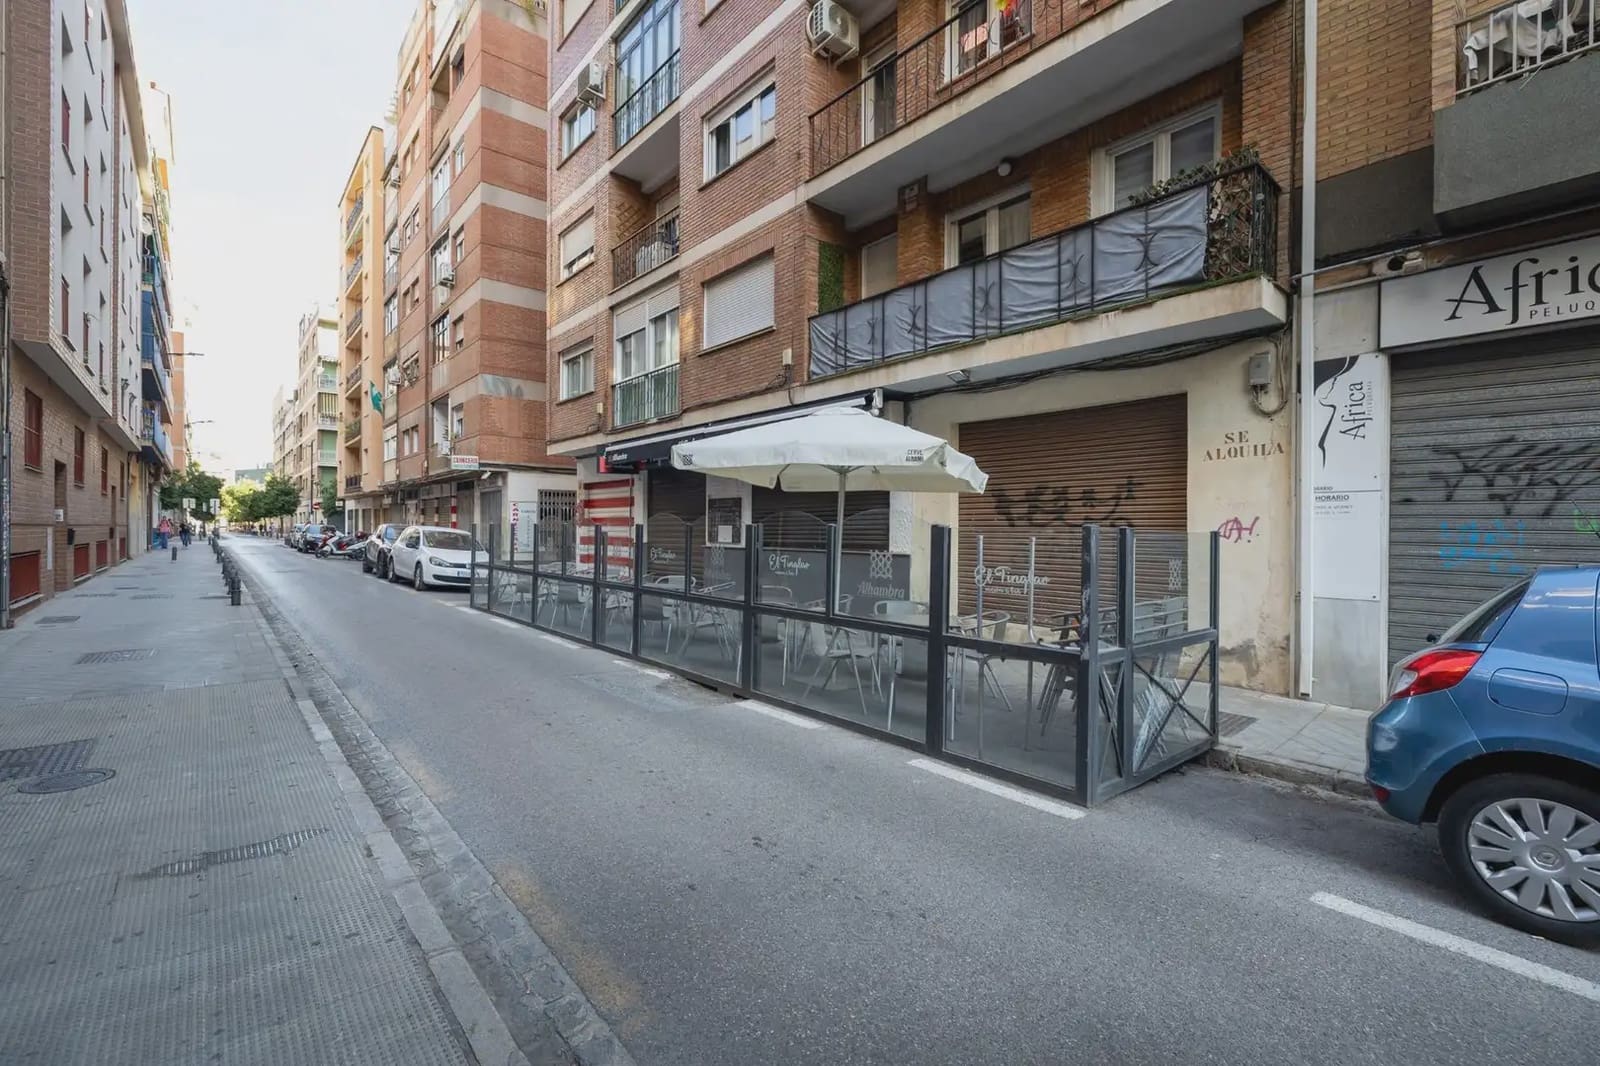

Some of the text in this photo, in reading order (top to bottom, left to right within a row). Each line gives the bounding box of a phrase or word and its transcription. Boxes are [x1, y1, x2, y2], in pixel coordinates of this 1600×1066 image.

[1529, 300, 1596, 320] PELUQ
[1339, 381, 1373, 440] Africa
[1224, 430, 1249, 444] SE
[1203, 442, 1284, 462] ALQUILA
[857, 582, 905, 598] Alhambra
